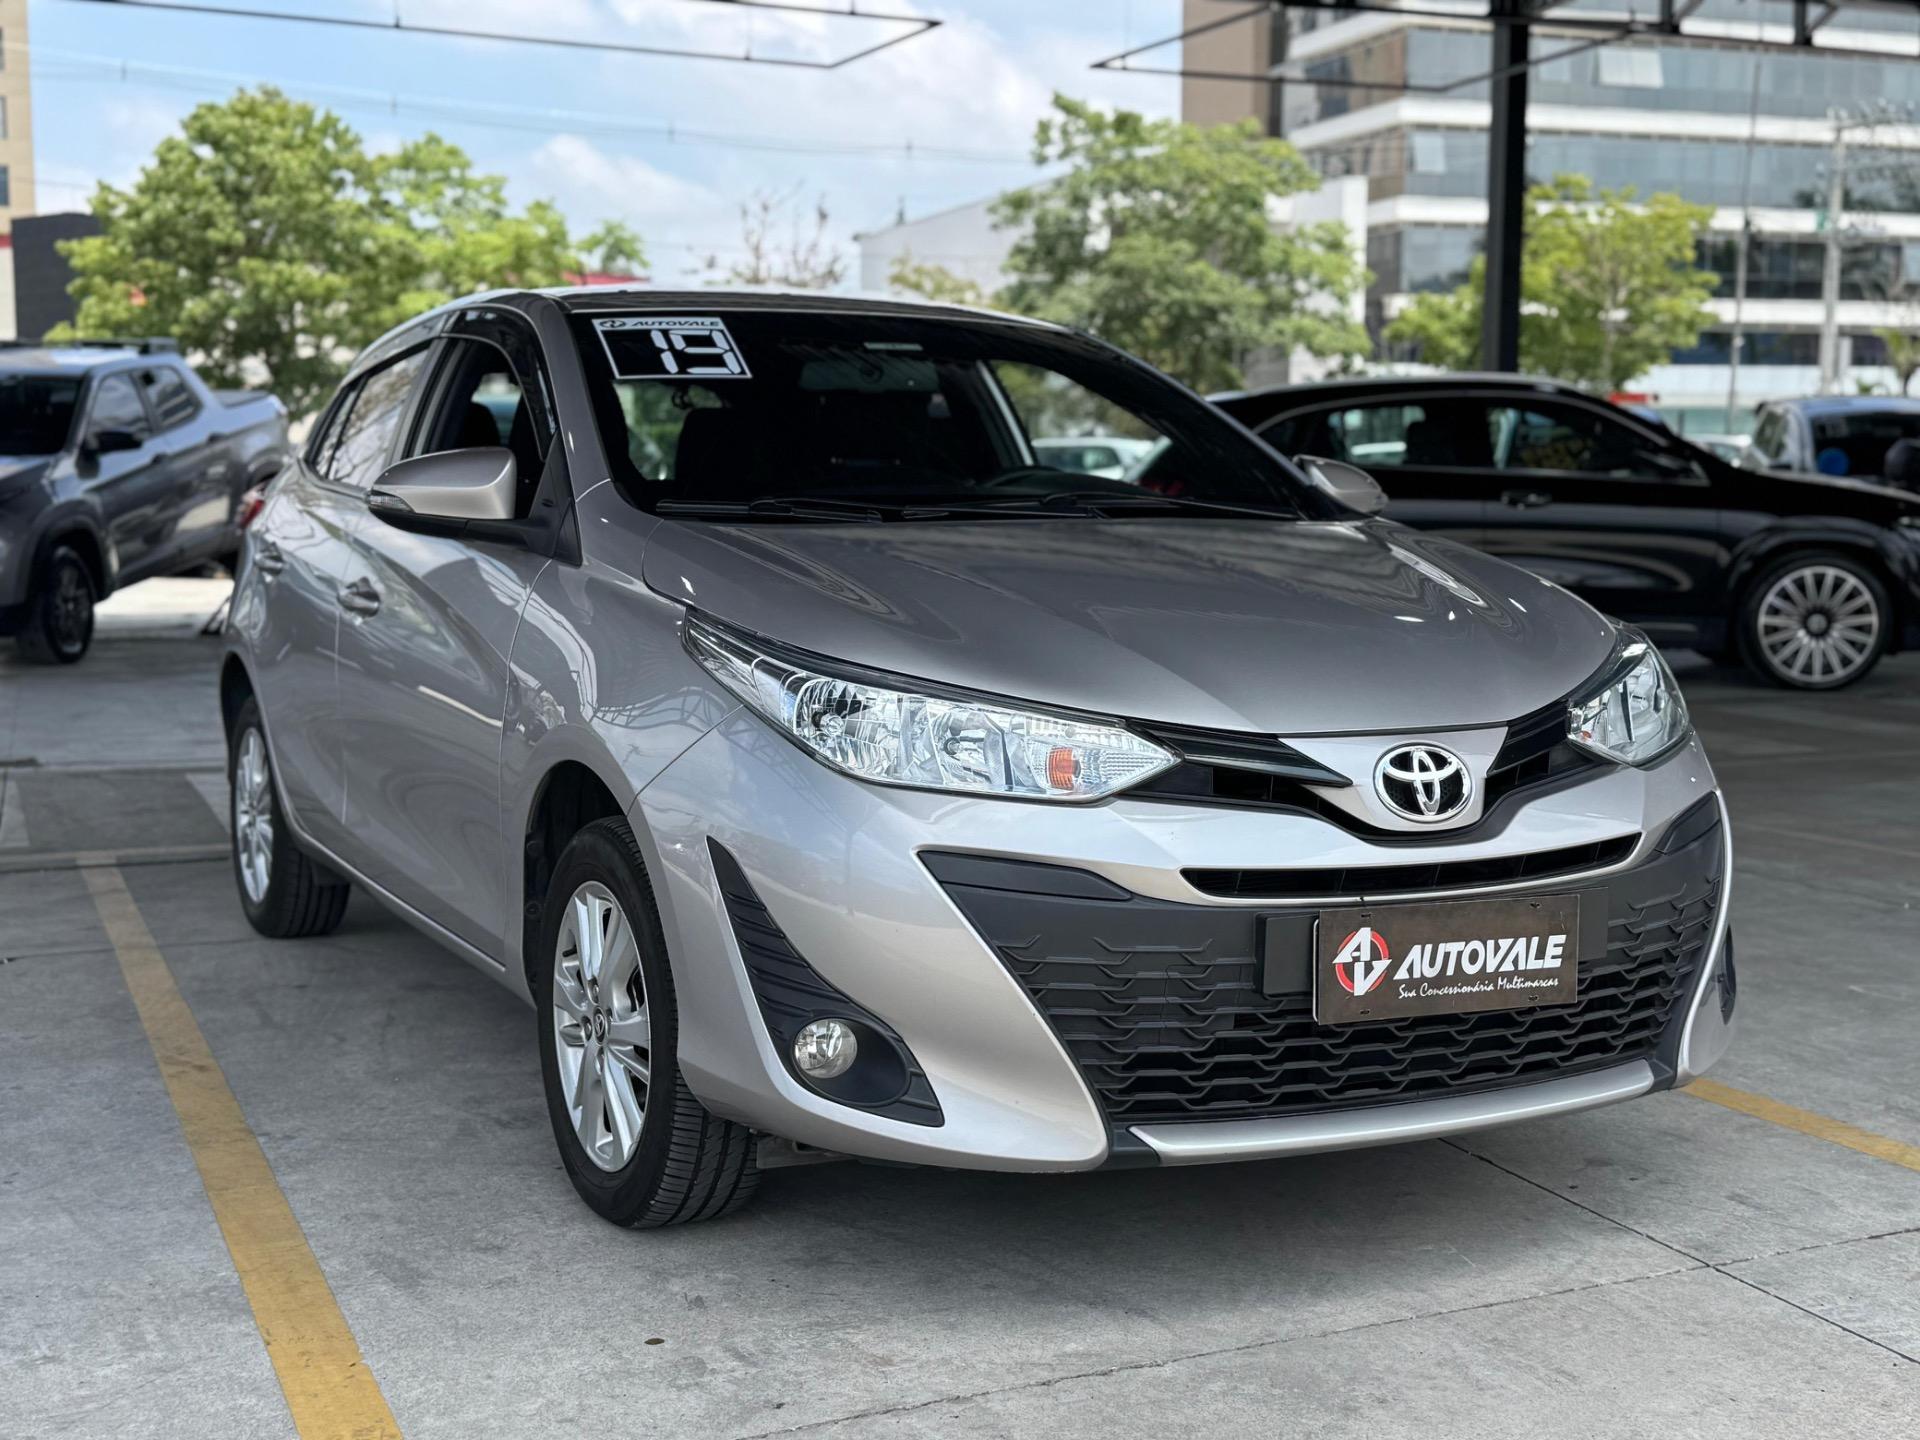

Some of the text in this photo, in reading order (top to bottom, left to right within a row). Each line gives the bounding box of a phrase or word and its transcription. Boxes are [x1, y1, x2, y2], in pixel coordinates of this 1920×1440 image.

[631, 320, 720, 328] AUTOVALE
[650, 329, 742, 375] 19
[1393, 934, 1567, 980] AUTOVALE
[1398, 975, 1559, 999] Sua Concessionária Multimarcas
